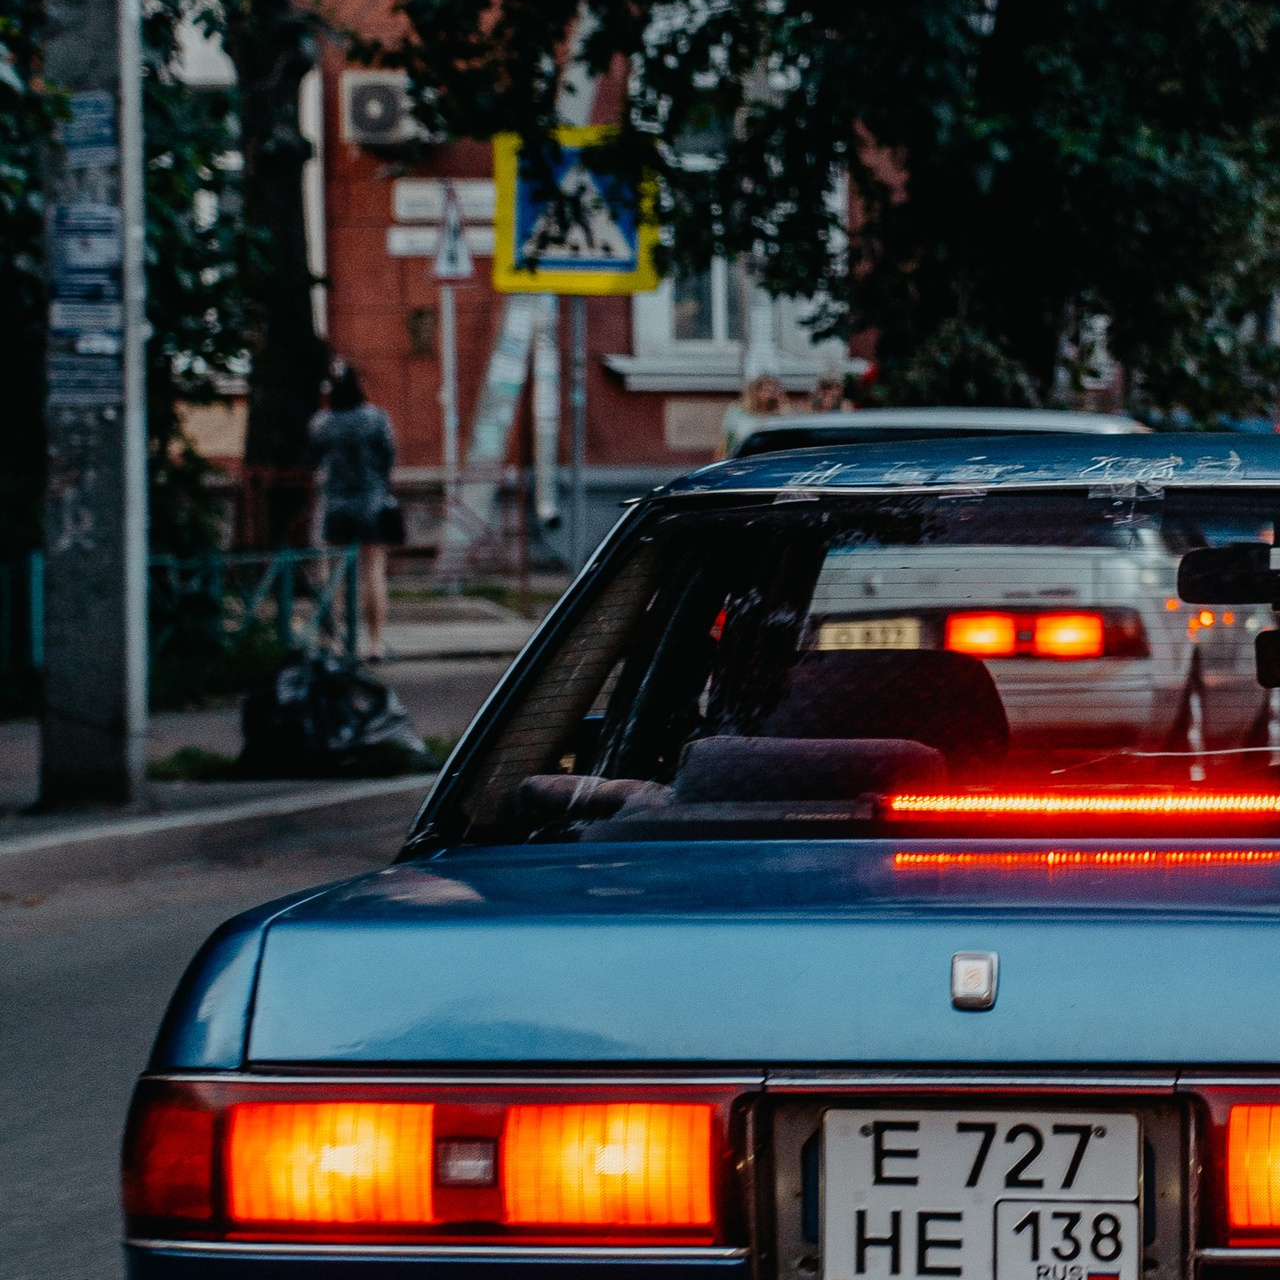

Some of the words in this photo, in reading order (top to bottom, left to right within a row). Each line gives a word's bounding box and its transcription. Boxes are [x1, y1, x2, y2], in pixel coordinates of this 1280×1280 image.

[872, 1120, 920, 1187] E
[955, 1122, 1095, 1189] 727
[854, 1209, 964, 1277] HE
[1012, 1210, 1123, 1263] 138
